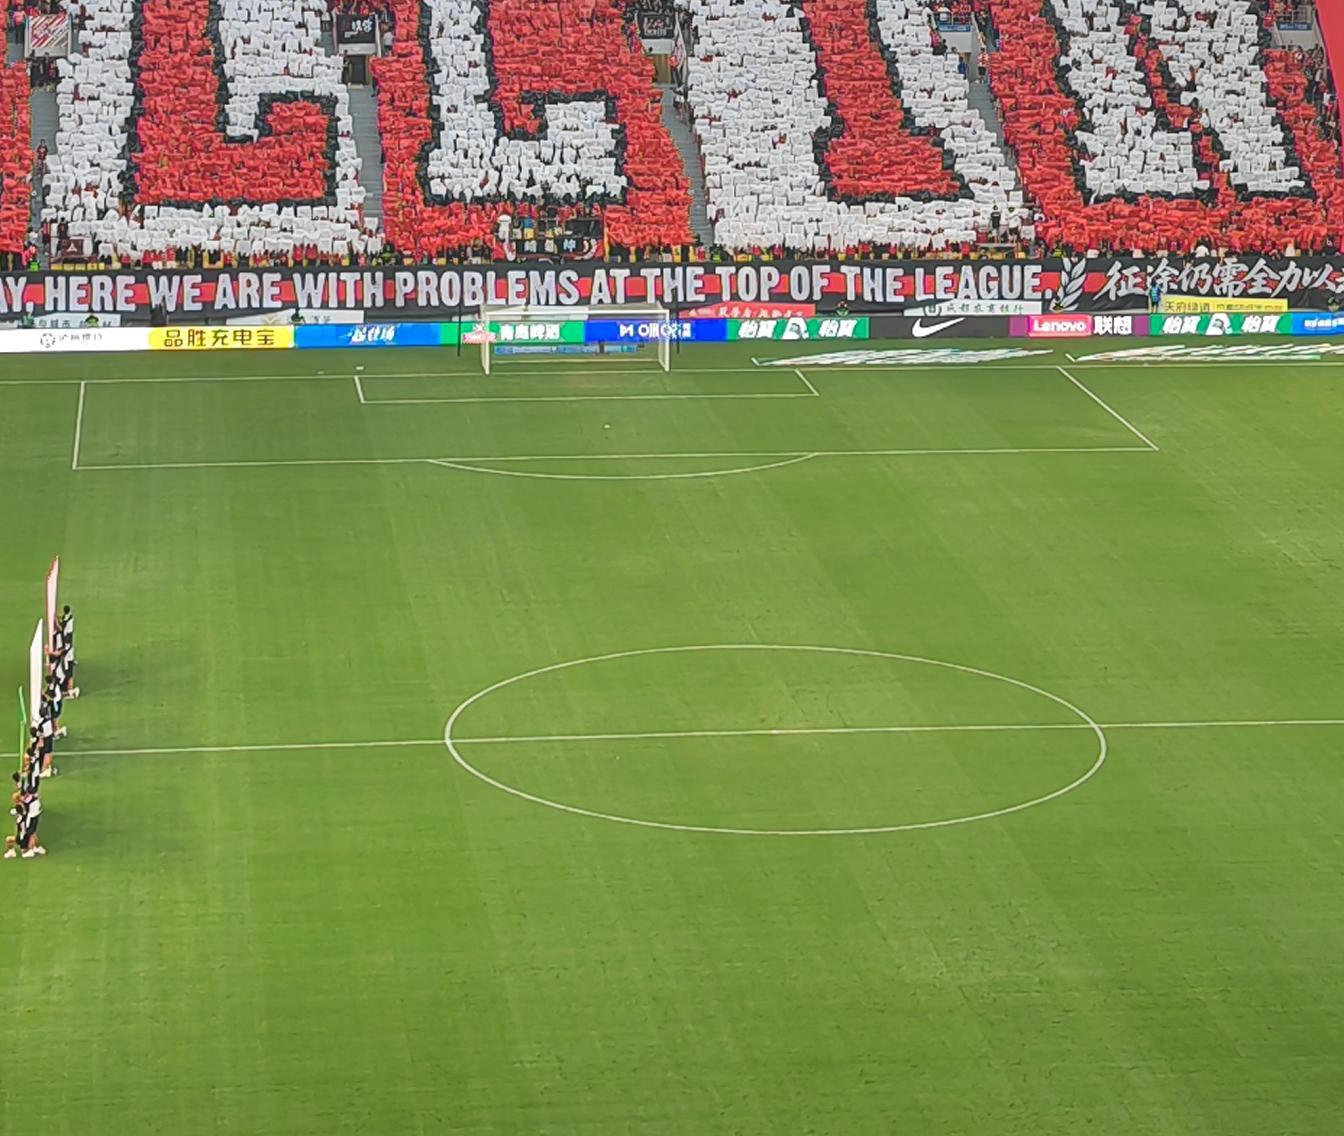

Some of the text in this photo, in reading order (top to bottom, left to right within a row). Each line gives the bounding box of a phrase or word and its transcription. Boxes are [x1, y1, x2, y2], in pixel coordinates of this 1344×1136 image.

[44, 274, 136, 312] HERE
[147, 272, 203, 311] WE
[213, 272, 283, 309] ARE
[292, 270, 384, 308] WITH
[395, 267, 580, 307] PROBLEMS
[590, 268, 632, 304] AT
[645, 267, 705, 303] THE
[714, 266, 785, 302] TOP
[789, 265, 832, 302] OF
[843, 265, 906, 303] THE
[914, 264, 1052, 302] LEAGUE.
[1032, 319, 1088, 332] Lenovo
[163, 329, 276, 347] 品胜充电宝
